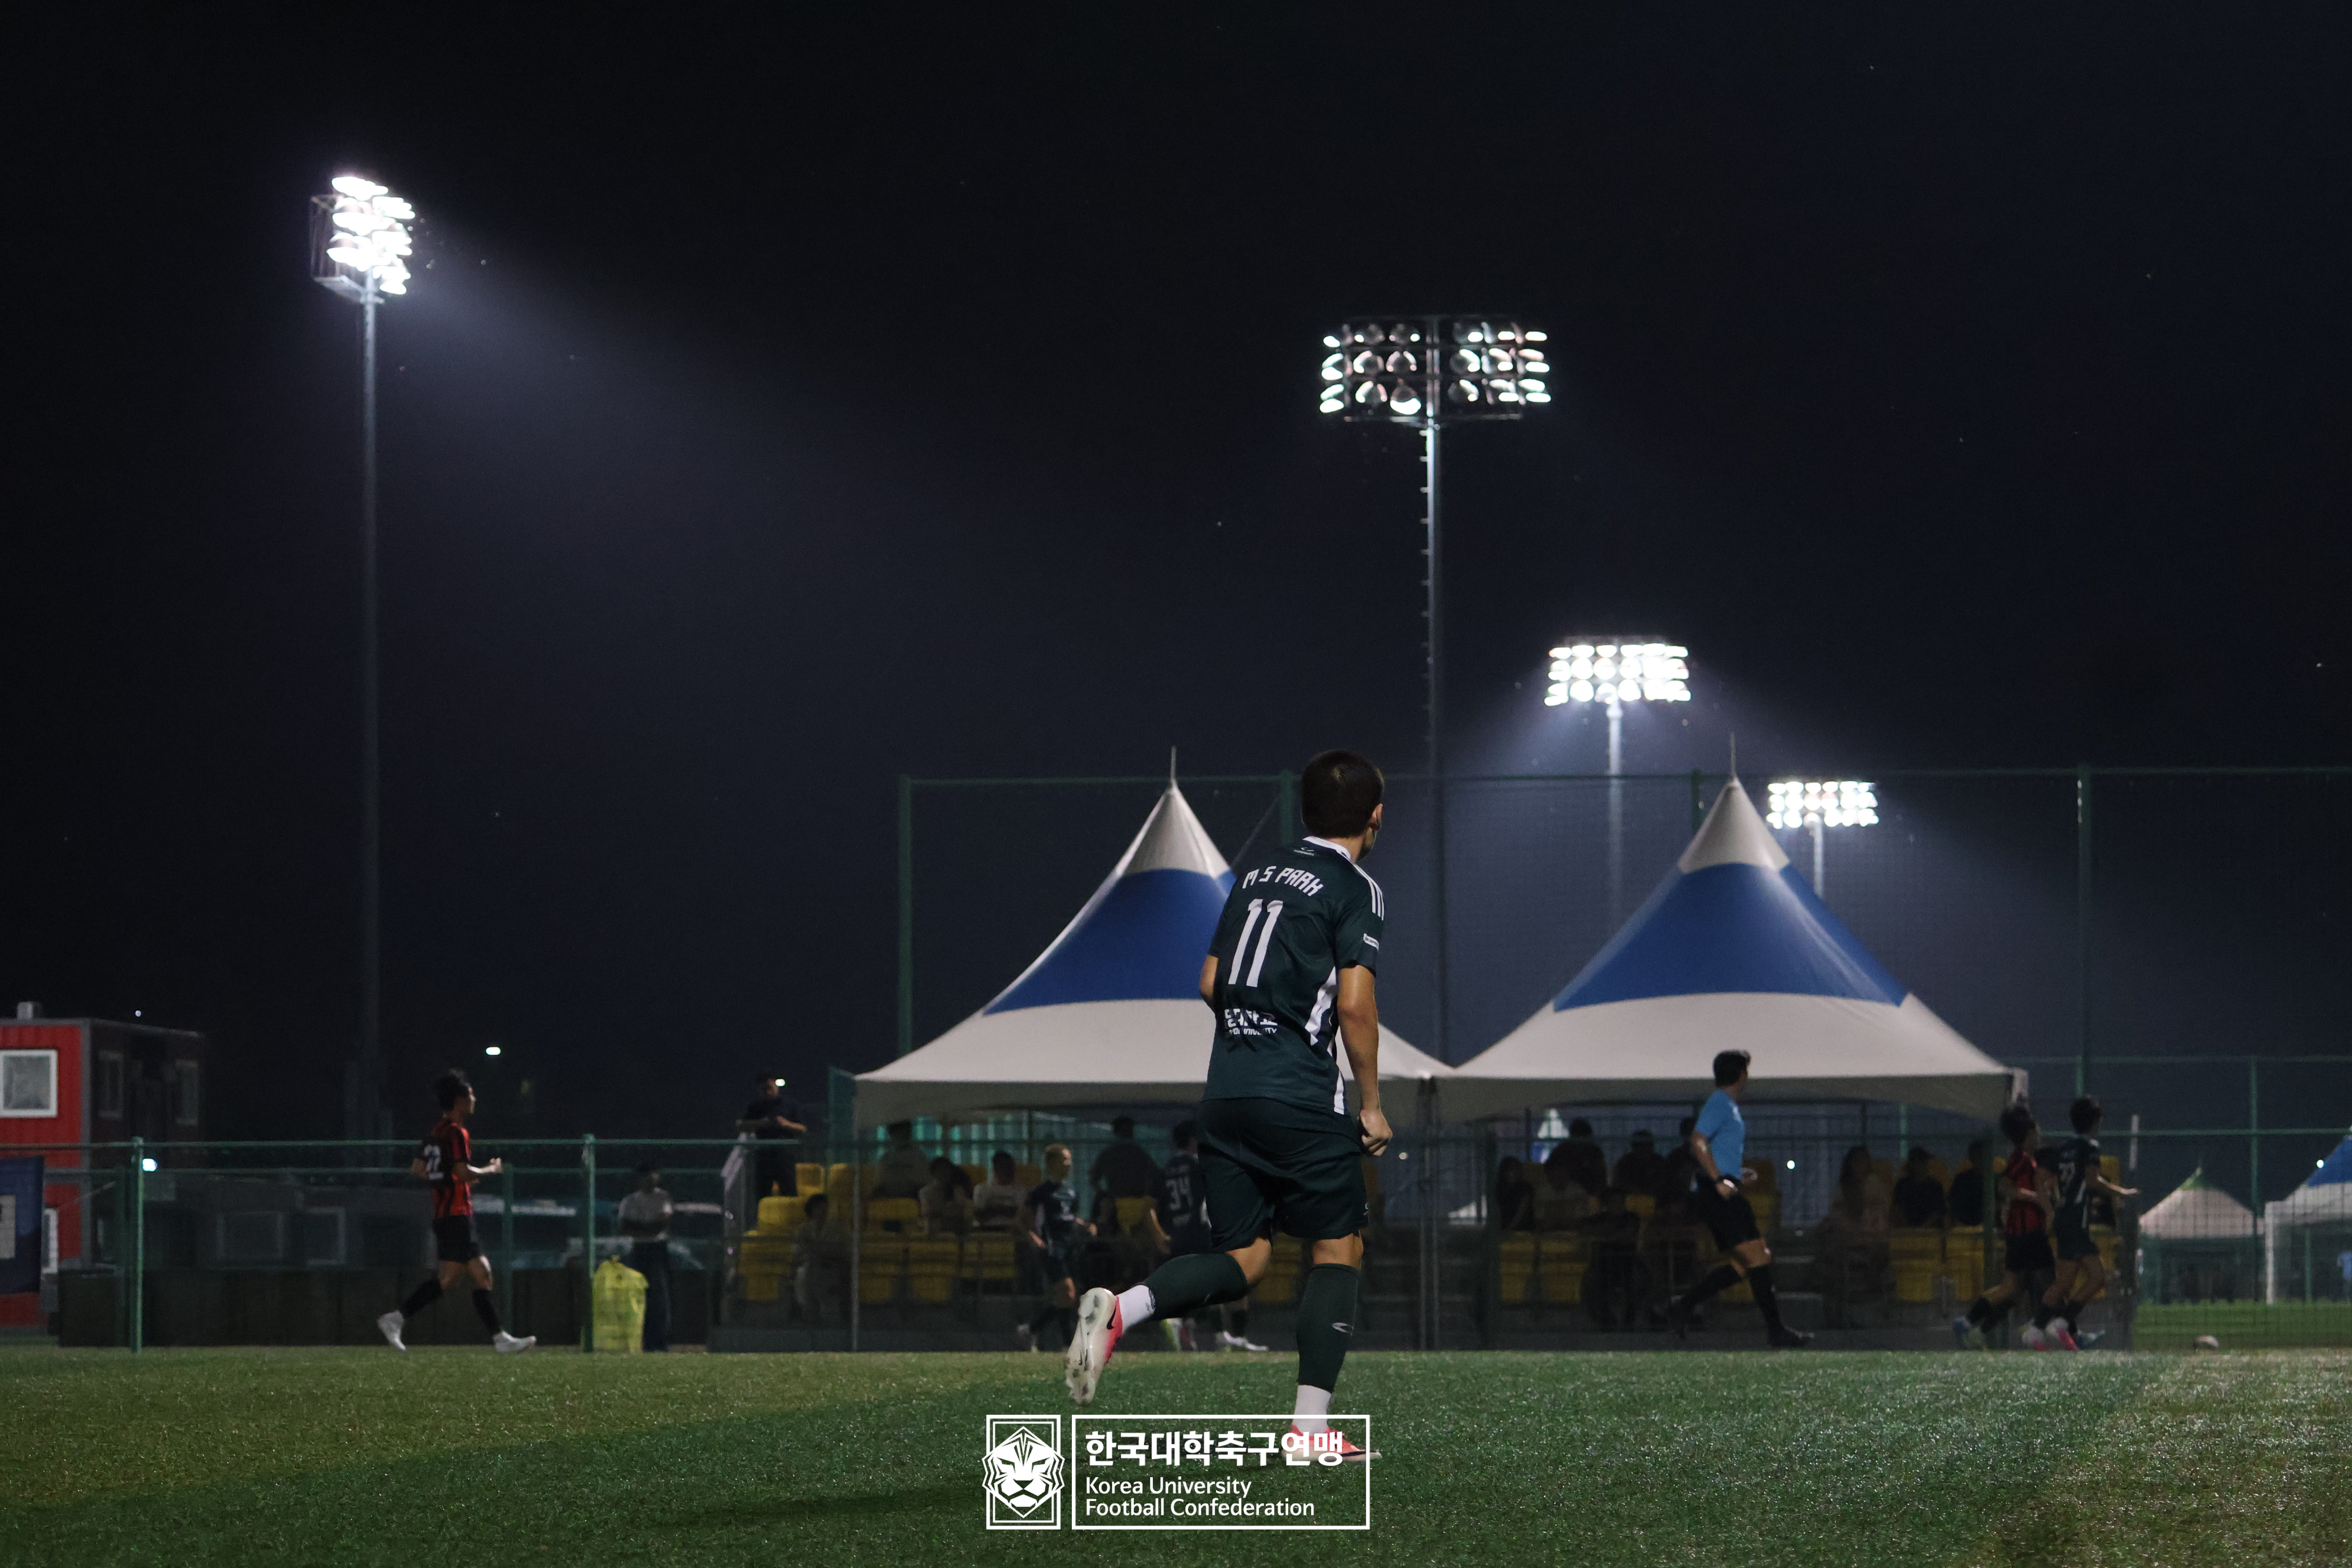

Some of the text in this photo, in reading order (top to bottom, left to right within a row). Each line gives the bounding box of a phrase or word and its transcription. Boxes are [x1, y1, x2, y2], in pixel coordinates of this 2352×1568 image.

[1242, 866, 1323, 896] M S PARK
[1228, 898, 1283, 987] 11
